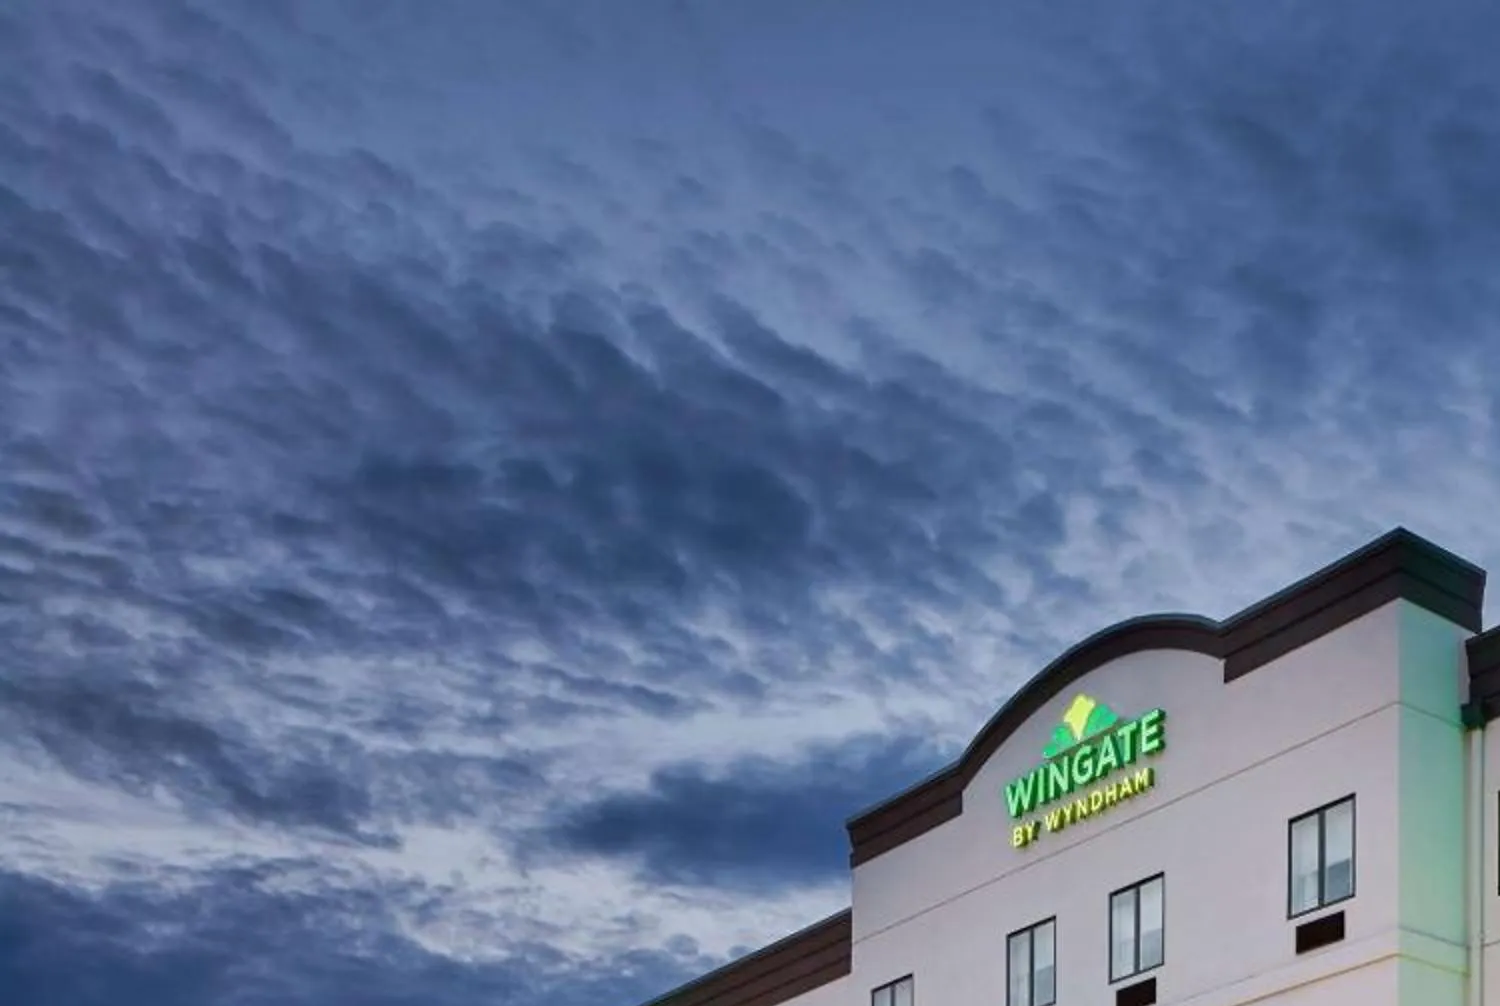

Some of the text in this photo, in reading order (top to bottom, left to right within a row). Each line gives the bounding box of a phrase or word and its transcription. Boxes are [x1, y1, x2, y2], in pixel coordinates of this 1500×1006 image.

[1005, 708, 1163, 818] WINGATE
[1012, 767, 1152, 848] BY WYNDHAM
